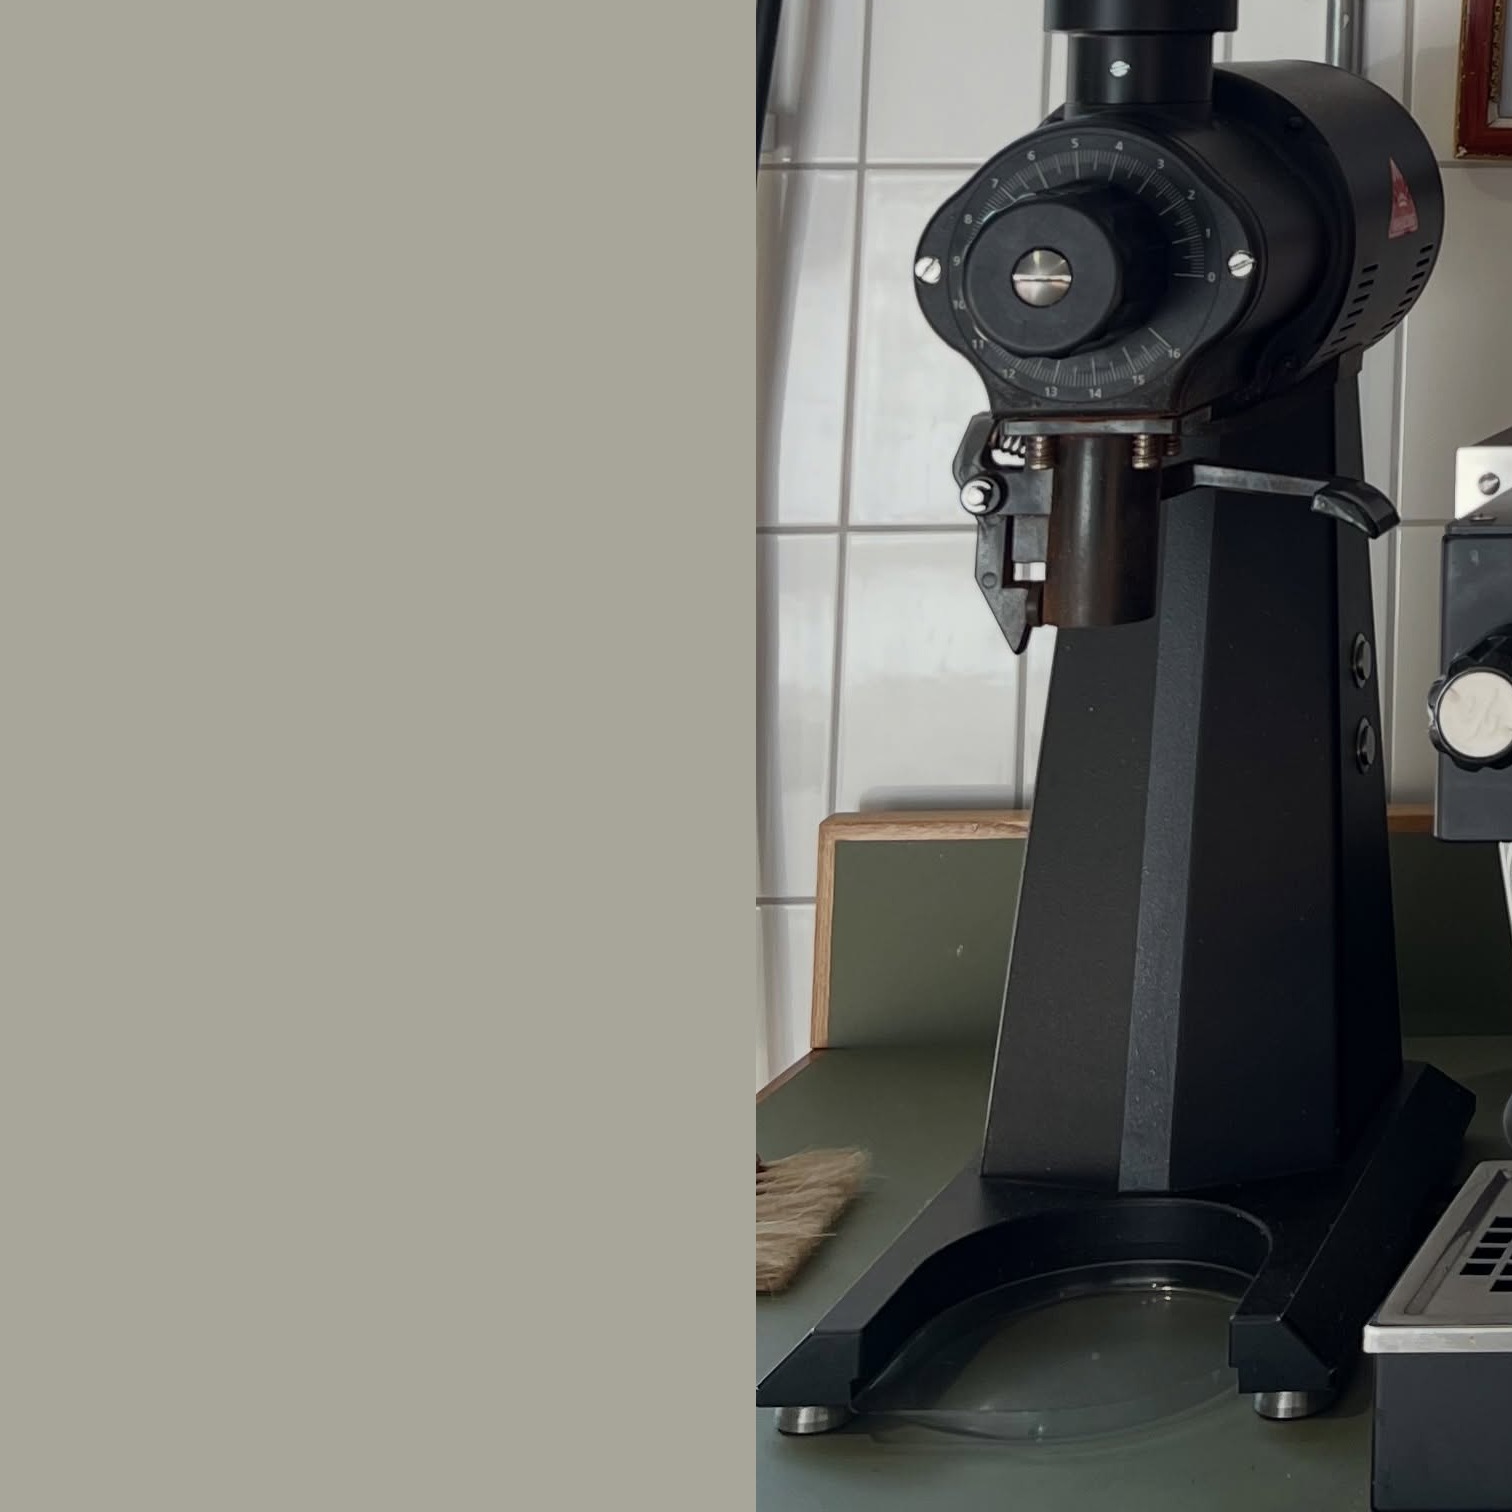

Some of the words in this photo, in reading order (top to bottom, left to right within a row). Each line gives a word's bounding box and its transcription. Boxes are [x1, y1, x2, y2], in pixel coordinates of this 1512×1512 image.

[1071, 138, 1079, 149] 5
[1115, 141, 1123, 151] 4
[1027, 150, 1035, 161] 6
[1157, 159, 1165, 169] 3
[1187, 190, 1195, 200] 2
[964, 214, 972, 224] 8
[1205, 228, 1211, 238] 1
[953, 255, 961, 266] 9
[1207, 272, 1216, 282] 0
[1168, 349, 1181, 359] 16
[1003, 369, 1015, 379] 12
[1132, 375, 1145, 385] 15
[1045, 387, 1058, 397] 13
[1089, 389, 1102, 399] 14
